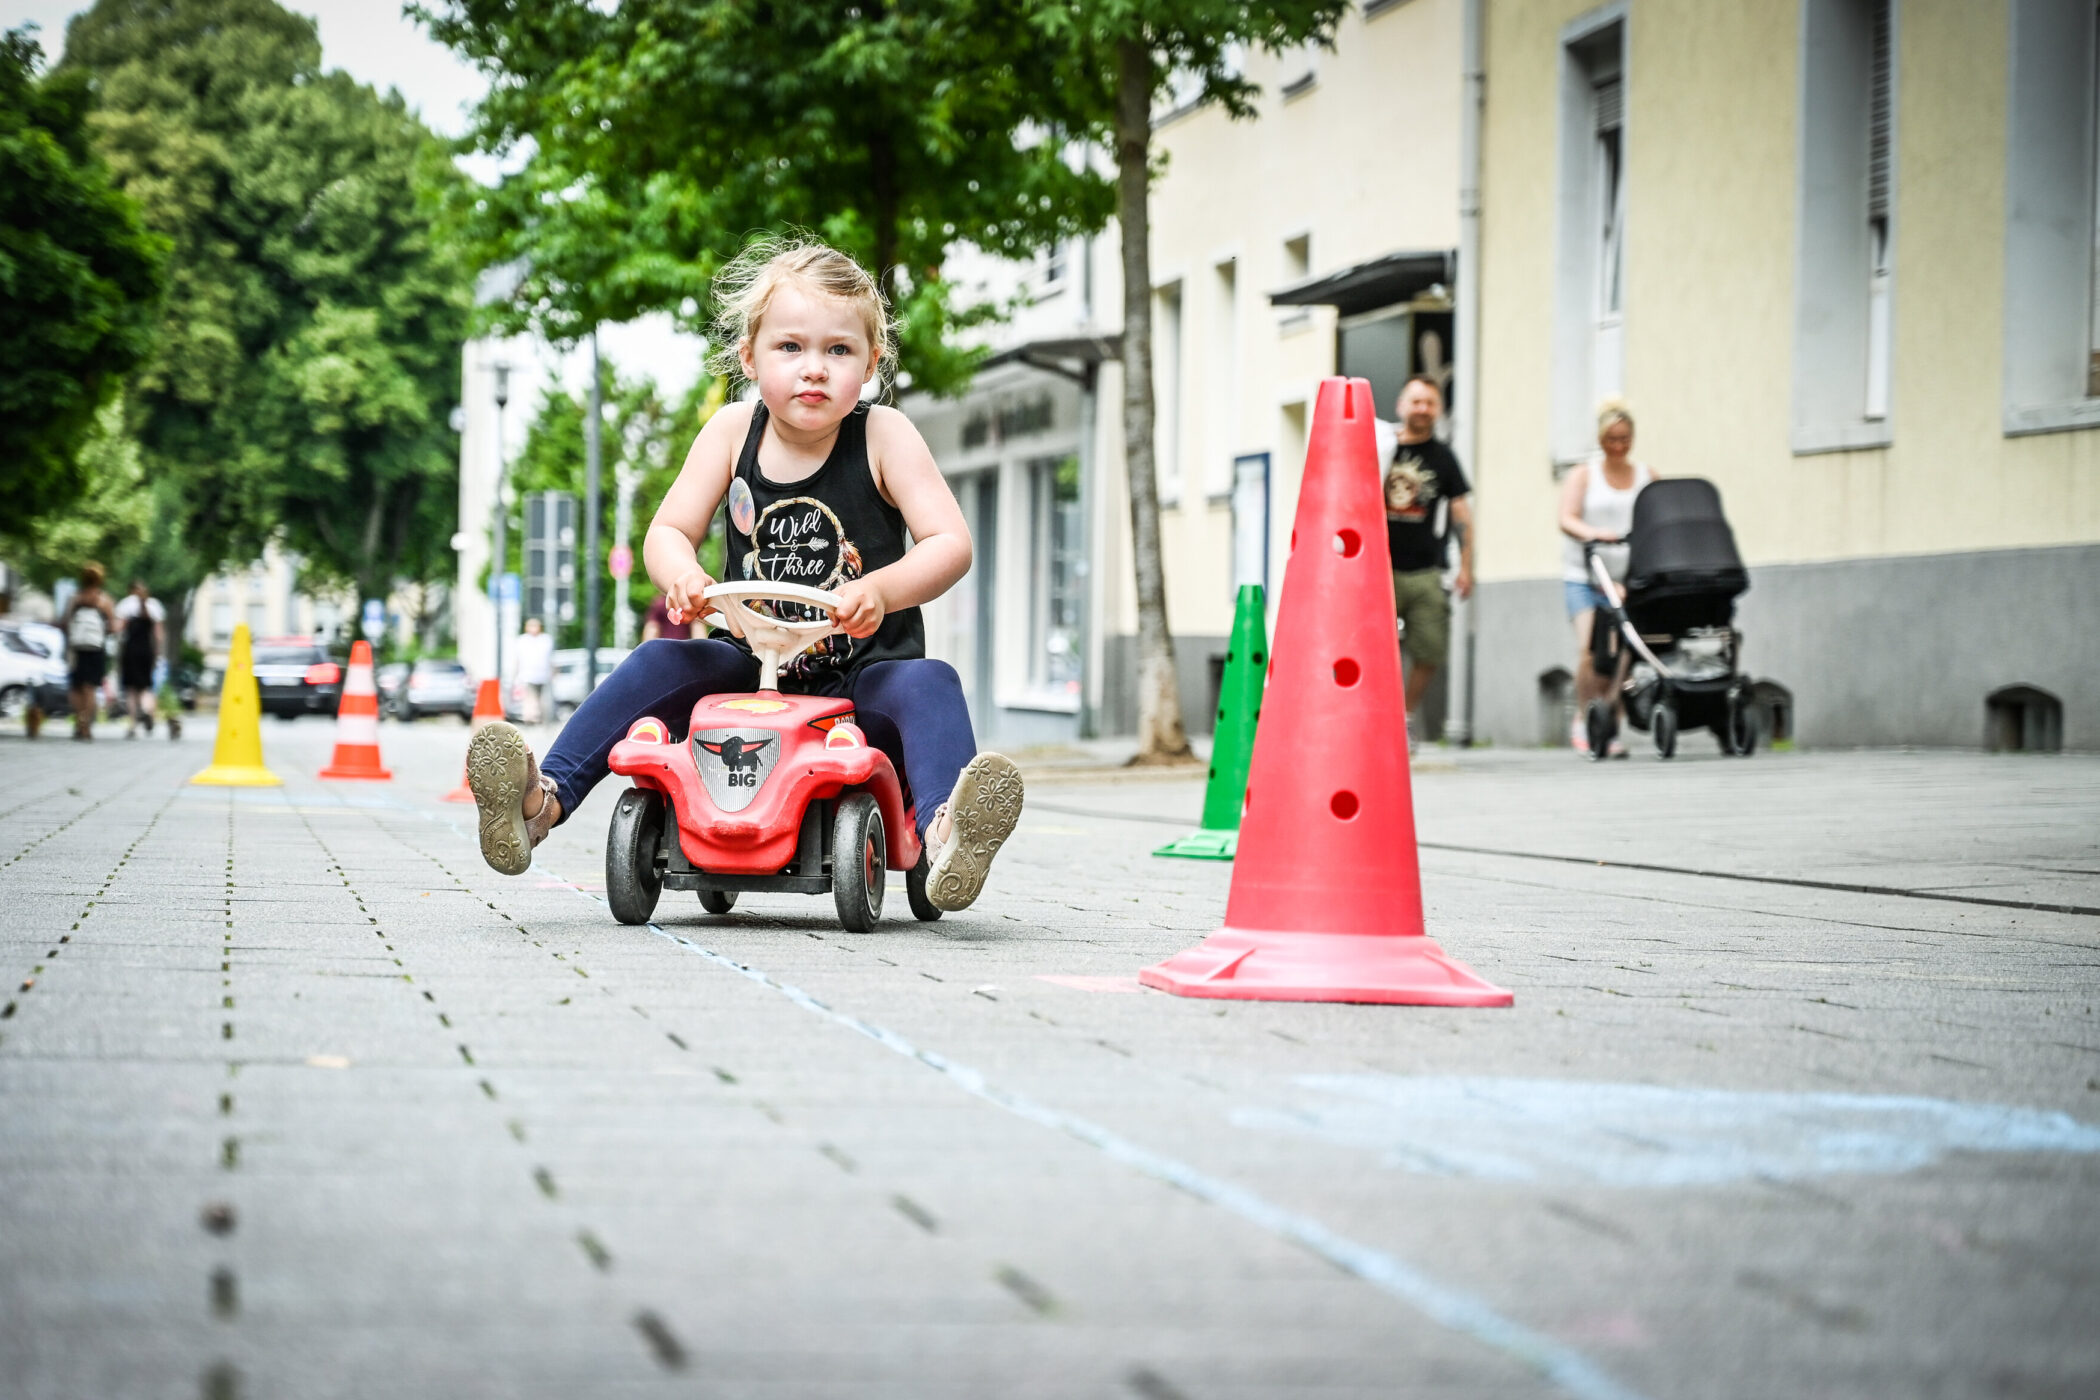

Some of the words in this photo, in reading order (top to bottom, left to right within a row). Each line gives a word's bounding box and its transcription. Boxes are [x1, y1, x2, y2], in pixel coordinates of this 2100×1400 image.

[770, 508, 822, 544] Wild
[790, 539, 799, 552] &
[728, 773, 756, 787] BIG
